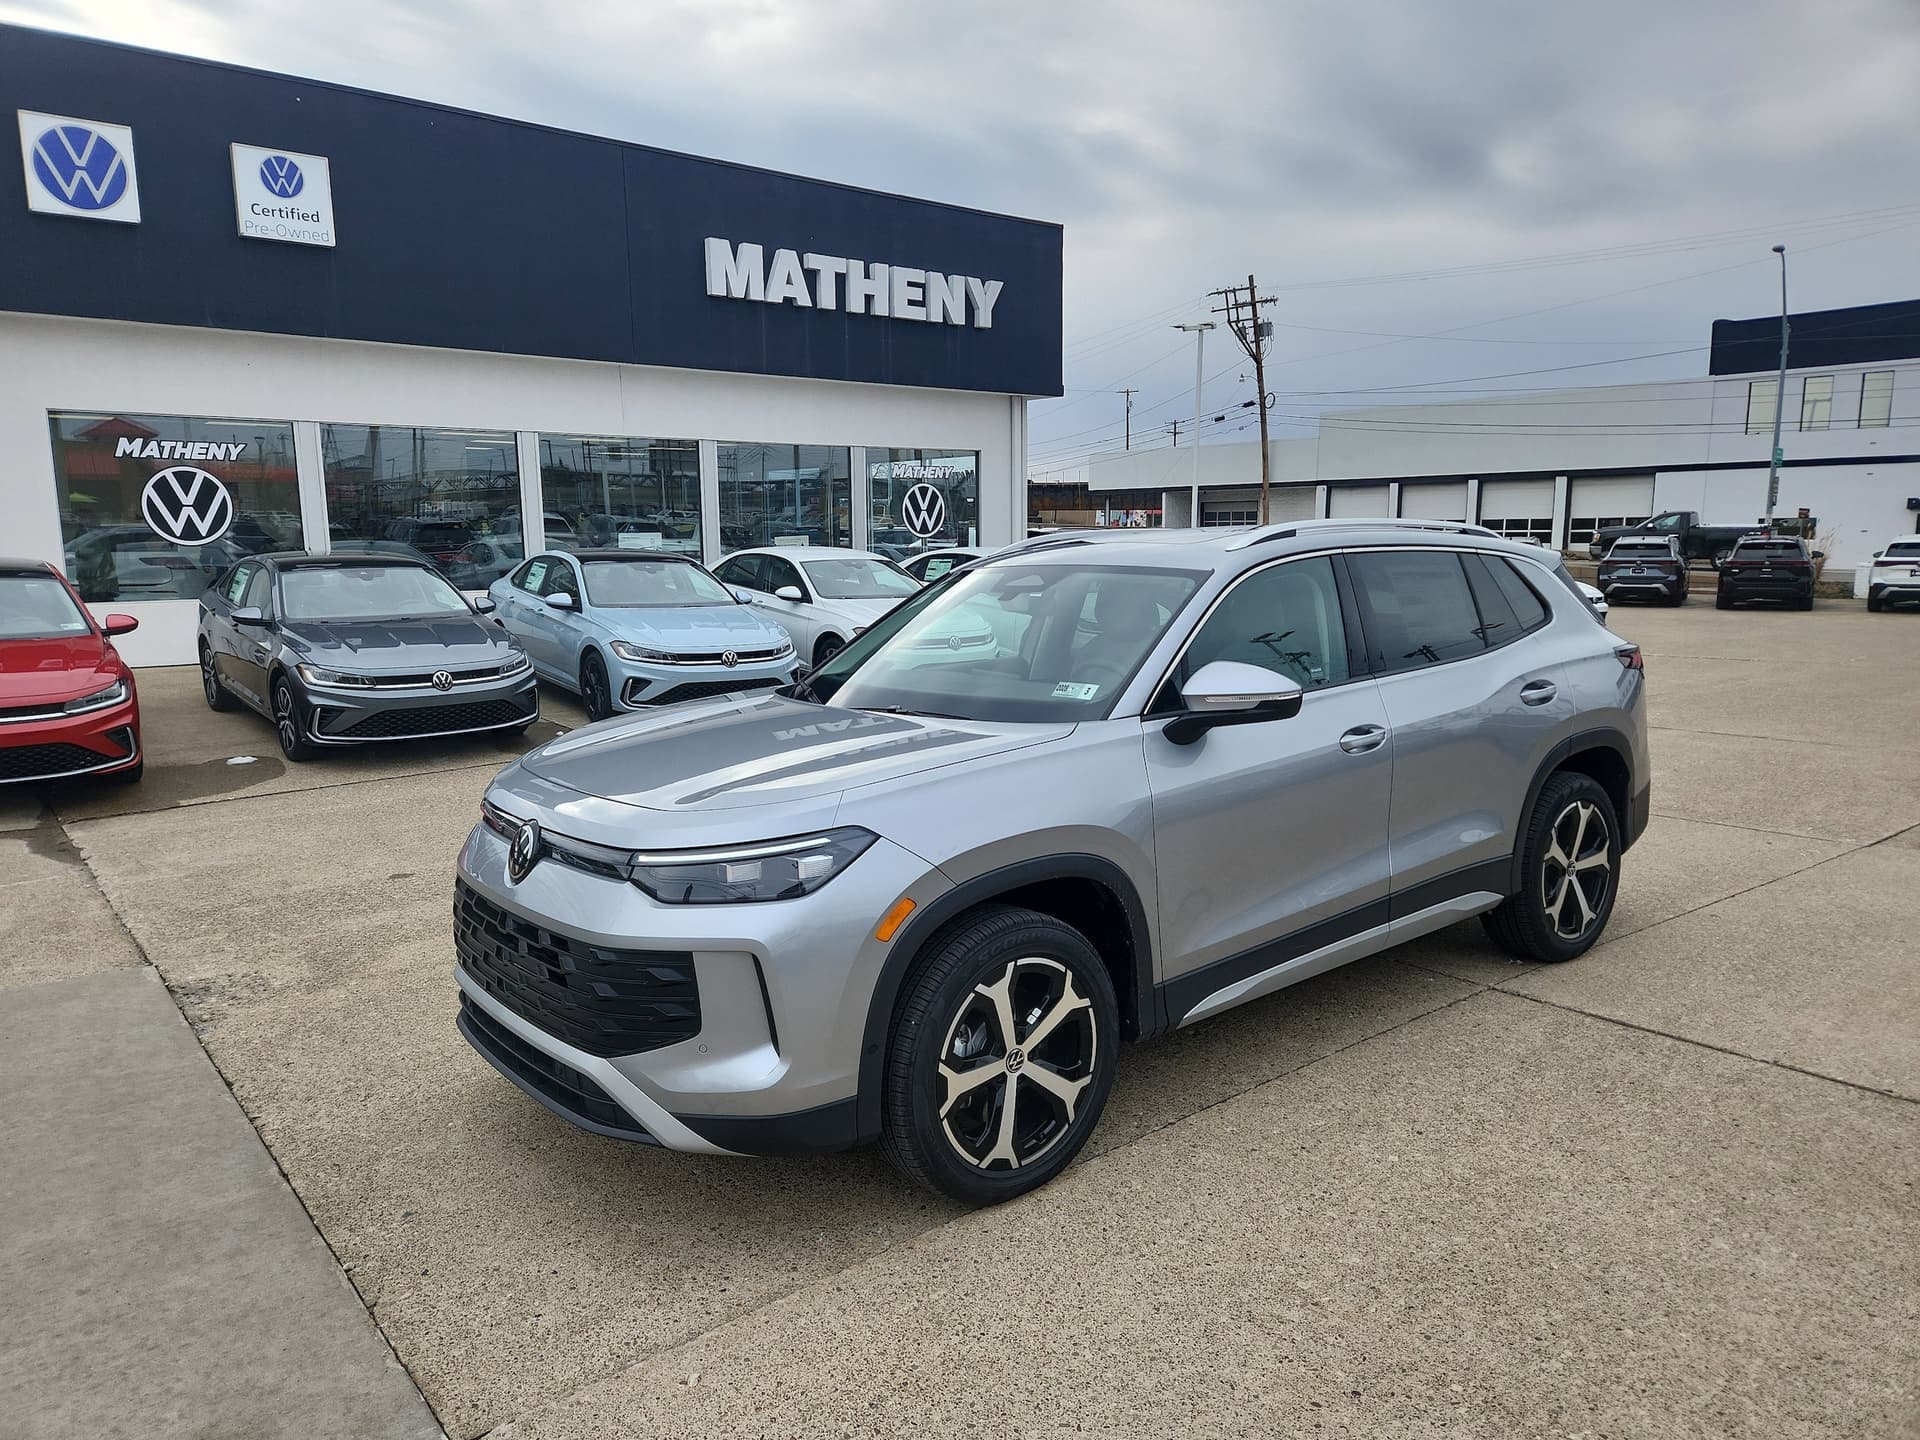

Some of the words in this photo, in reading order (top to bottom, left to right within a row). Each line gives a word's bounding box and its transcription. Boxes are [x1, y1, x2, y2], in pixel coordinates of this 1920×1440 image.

[251, 203, 320, 222] Certified
[244, 220, 331, 242] Pre-Owned
[704, 236, 1004, 329] MATHENY
[114, 437, 246, 461] MATHENY
[891, 464, 953, 479] MATHENY
